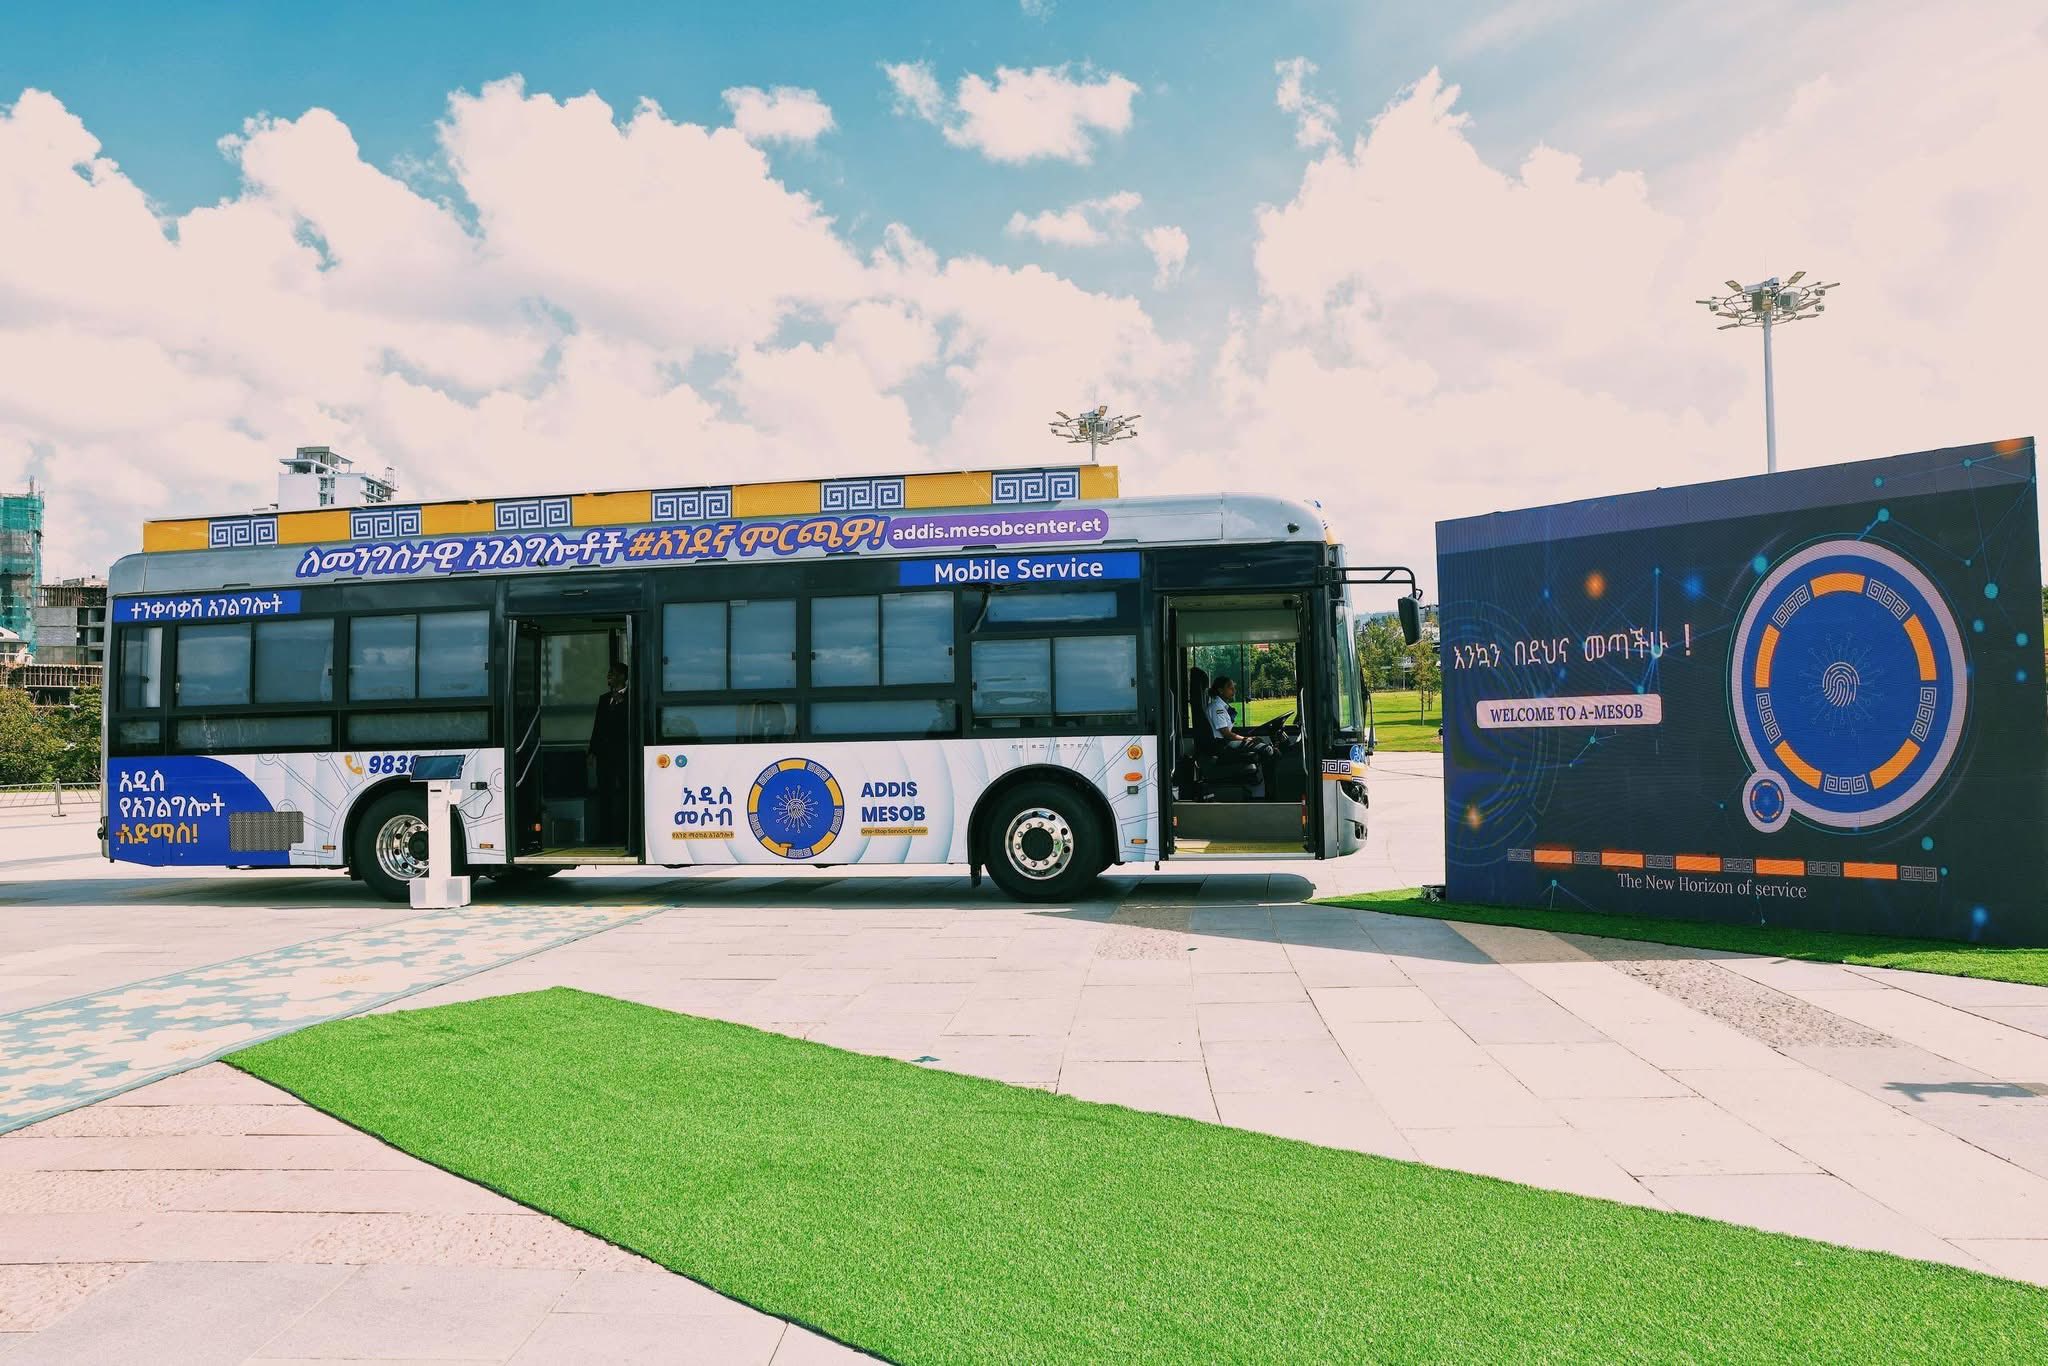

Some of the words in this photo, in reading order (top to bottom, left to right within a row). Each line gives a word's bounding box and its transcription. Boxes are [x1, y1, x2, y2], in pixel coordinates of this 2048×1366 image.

[893, 517, 1102, 541] addis.mesobcenter.et
[300, 542, 464, 574] ለመንግስታዊ
[466, 531, 624, 567] አገልግሎቶች
[629, 525, 736, 557] #አንደኛ
[740, 518, 885, 552] ምርጫዎ!
[935, 559, 1009, 584] Mobile
[1017, 557, 1104, 579] Service
[131, 598, 202, 619] ተንቀሳቃሽ
[207, 593, 283, 617] አገልግሎት
[1454, 643, 1501, 669] እንኳን
[1515, 637, 1570, 665] በደህና
[1585, 627, 1669, 661] መጣችሁ
[1490, 707, 1555, 723] WELCOME
[1558, 706, 1576, 721] TO
[1579, 704, 1643, 720] A-MESOB
[119, 770, 165, 792] አዲስ
[861, 782, 918, 798] ADDIS
[119, 793, 225, 818] የአገልግሎት
[683, 786, 732, 805] አዲስ
[674, 807, 733, 826] መሶብ
[861, 806, 926, 822] MESOB
[118, 822, 199, 844] አድማስ!
[1618, 873, 1642, 888] The
[1646, 875, 1674, 890] New
[1679, 877, 1733, 894] Horizon
[1737, 879, 1752, 895] of
[1755, 882, 1807, 899] service
